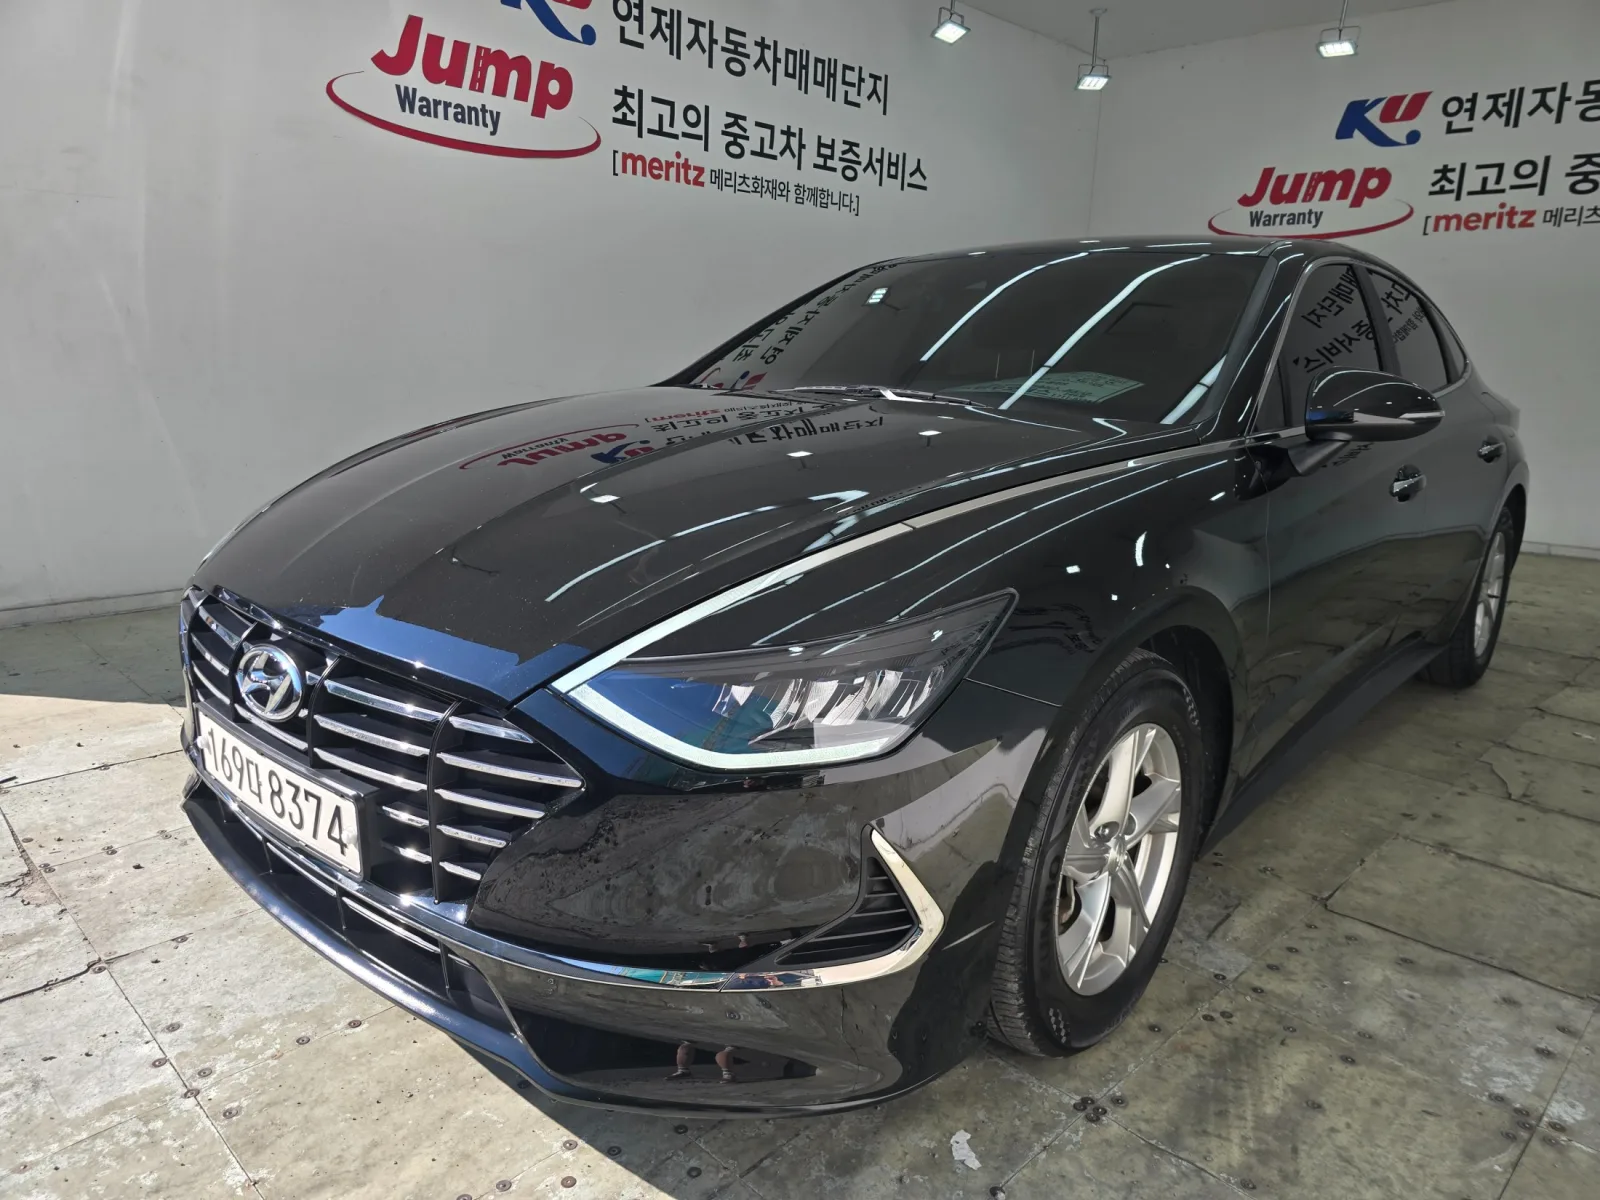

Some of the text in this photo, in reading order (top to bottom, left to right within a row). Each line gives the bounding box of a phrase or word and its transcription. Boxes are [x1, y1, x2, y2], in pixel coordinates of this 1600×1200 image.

[371, 14, 573, 119] Jump
[612, 0, 889, 116] 연제자동차매매단지
[395, 83, 501, 136] Warranty
[612, 84, 928, 192] 최고의 중고차 보증서비스
[709, 168, 791, 200] 메리츠화재와
[1237, 167, 1392, 208] Jump
[1428, 155, 1552, 201] 최고의
[1249, 208, 1323, 228] Warranty
[208, 727, 348, 857] 169마 8374
